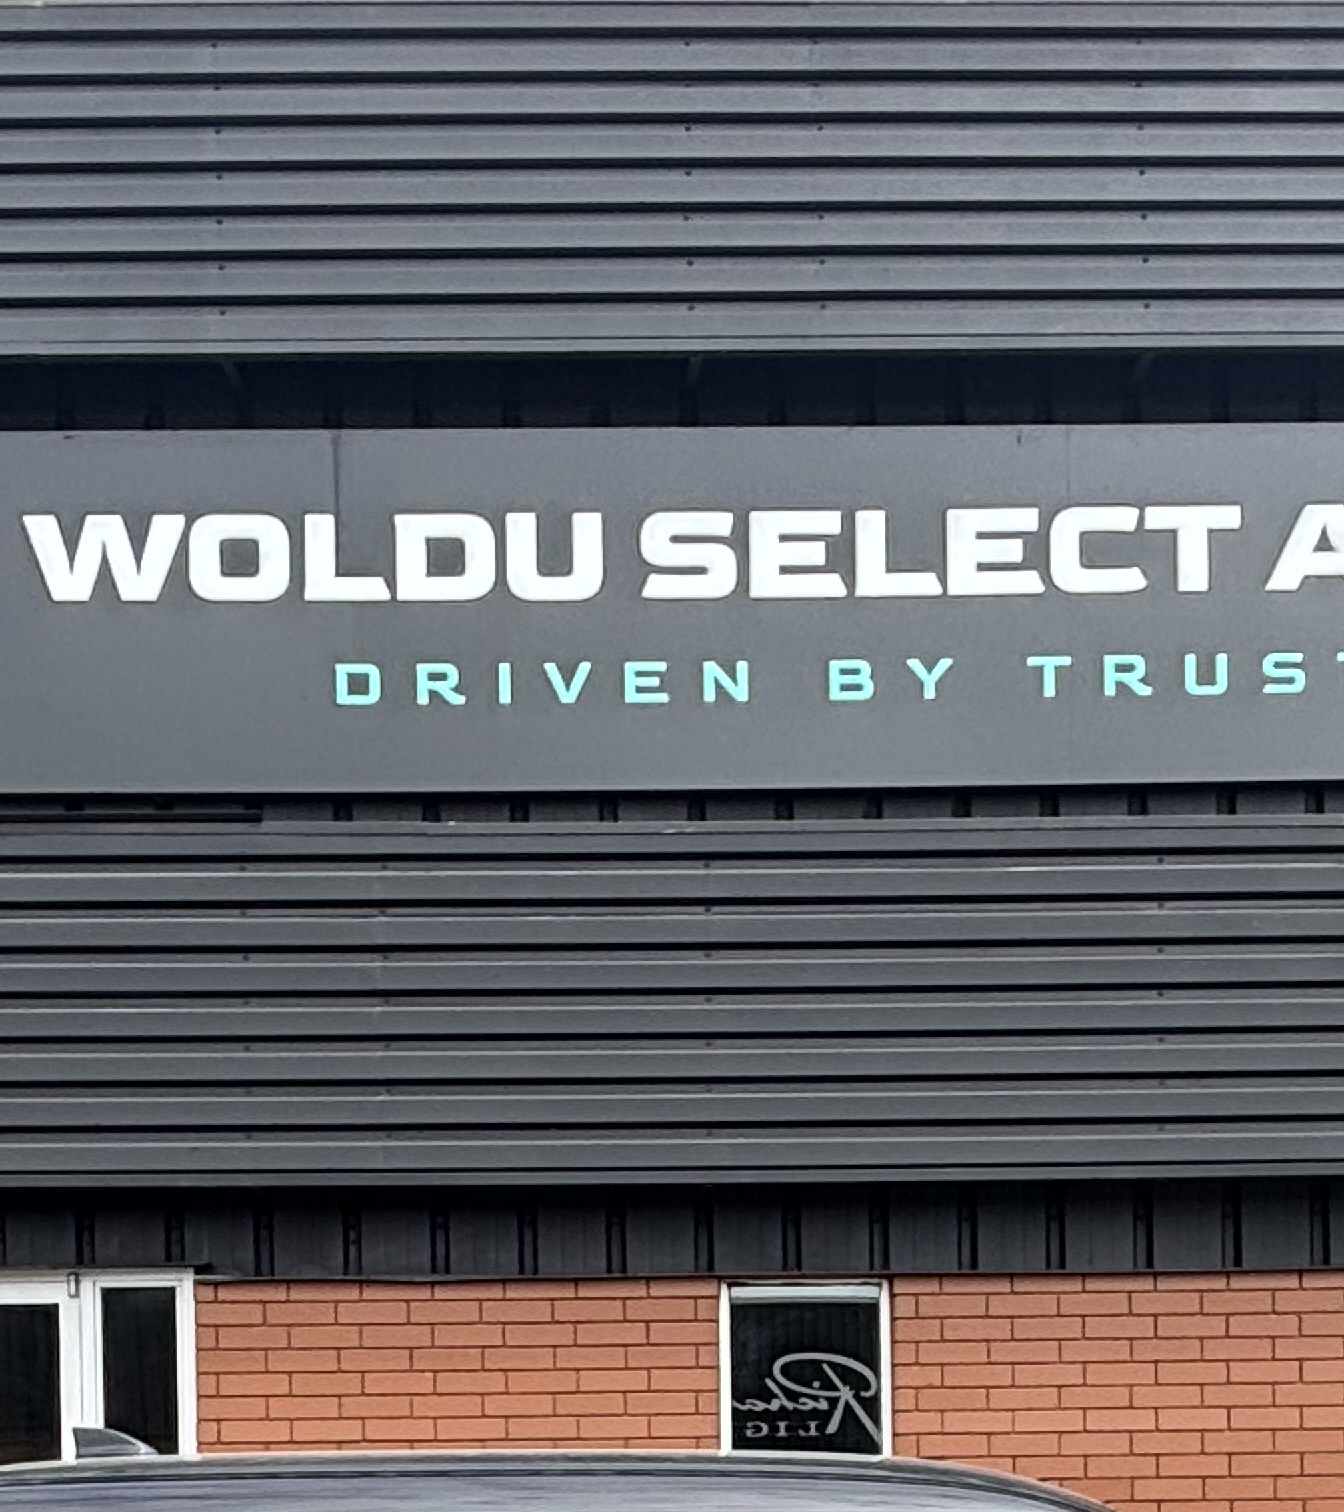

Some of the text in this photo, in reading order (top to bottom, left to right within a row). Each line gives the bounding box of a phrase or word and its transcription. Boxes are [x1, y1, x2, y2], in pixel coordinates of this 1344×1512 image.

[22, 512, 604, 603] WOLDU
[639, 502, 1242, 601] SELECT
[334, 660, 750, 707] DRIVEN
[828, 657, 953, 703] BY
